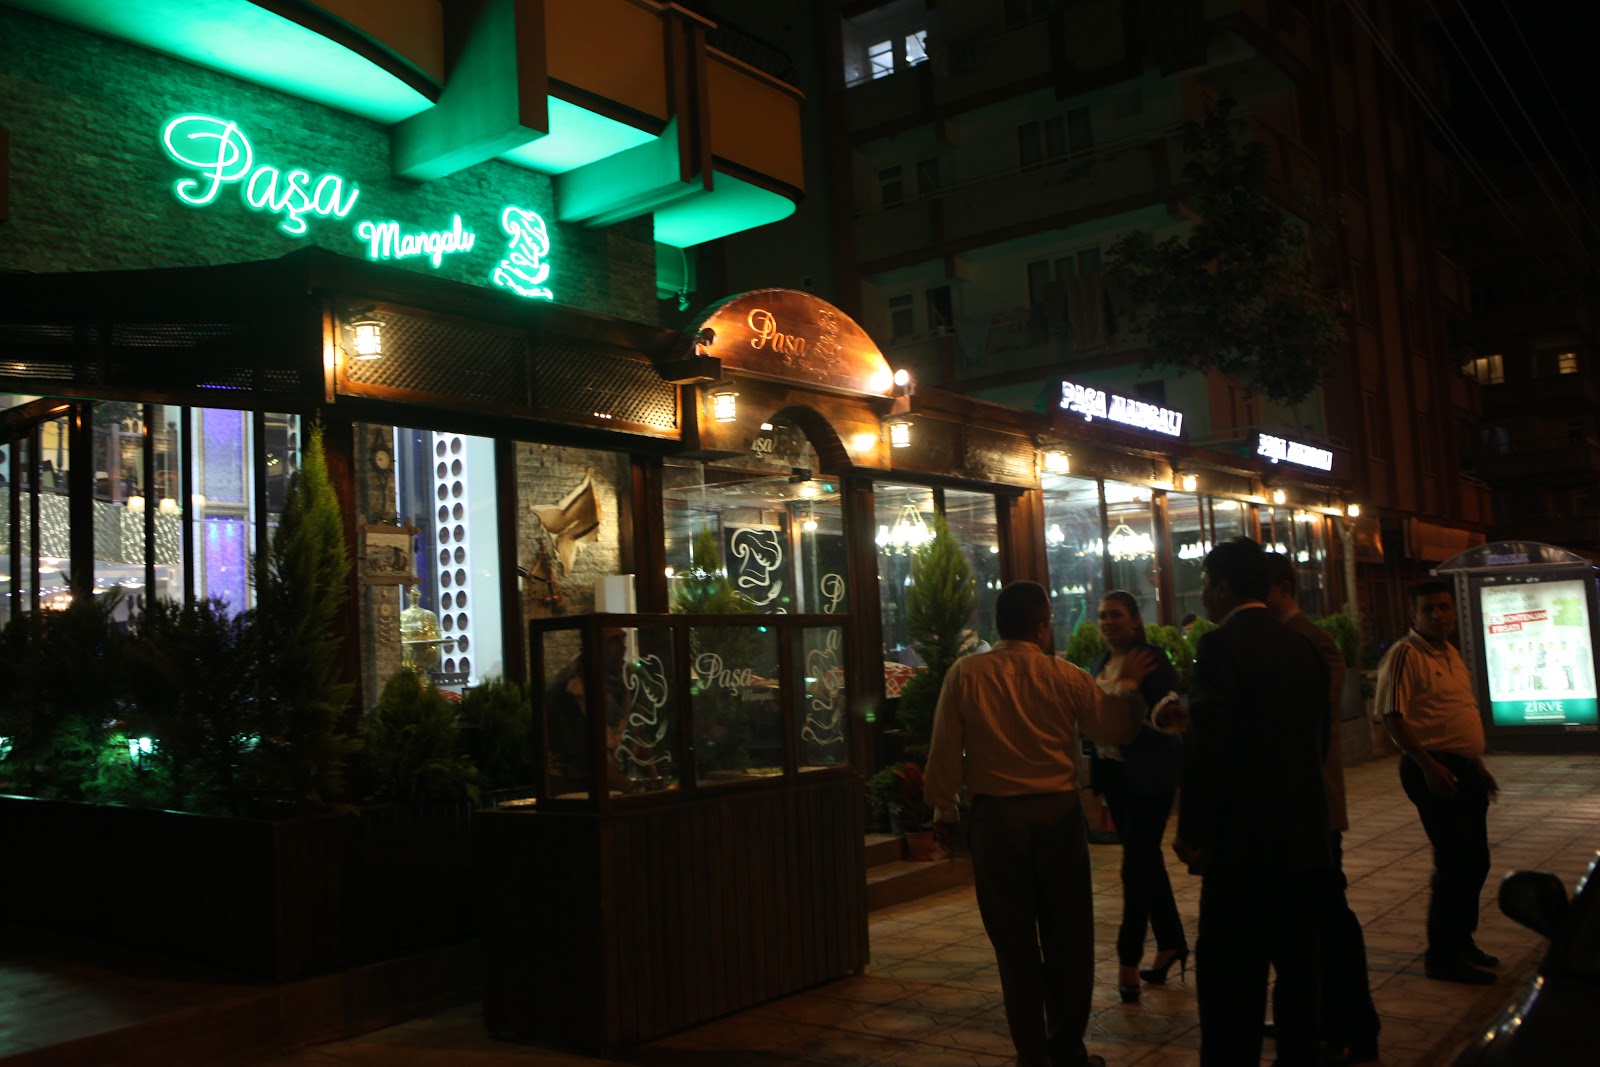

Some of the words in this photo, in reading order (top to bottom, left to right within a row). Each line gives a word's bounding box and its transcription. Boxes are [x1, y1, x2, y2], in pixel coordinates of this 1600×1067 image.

[163, 114, 360, 234] Paşa
[1060, 380, 1107, 422] PAŞA
[695, 652, 753, 697] Paşa
